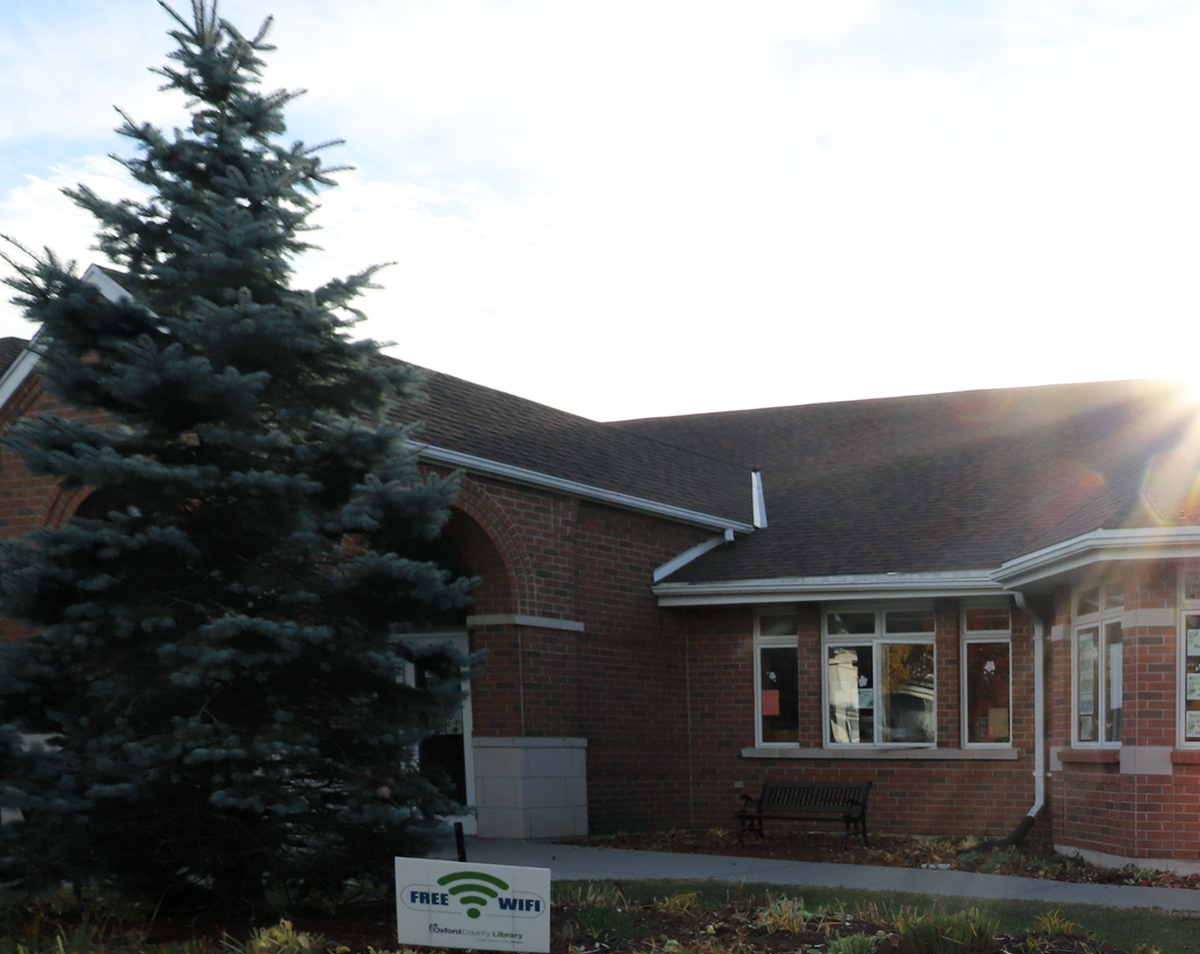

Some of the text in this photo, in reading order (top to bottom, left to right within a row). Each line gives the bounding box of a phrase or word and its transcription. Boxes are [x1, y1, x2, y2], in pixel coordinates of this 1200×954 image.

[410, 891, 540, 912] FREE WIFI
[492, 931, 523, 939] Library
